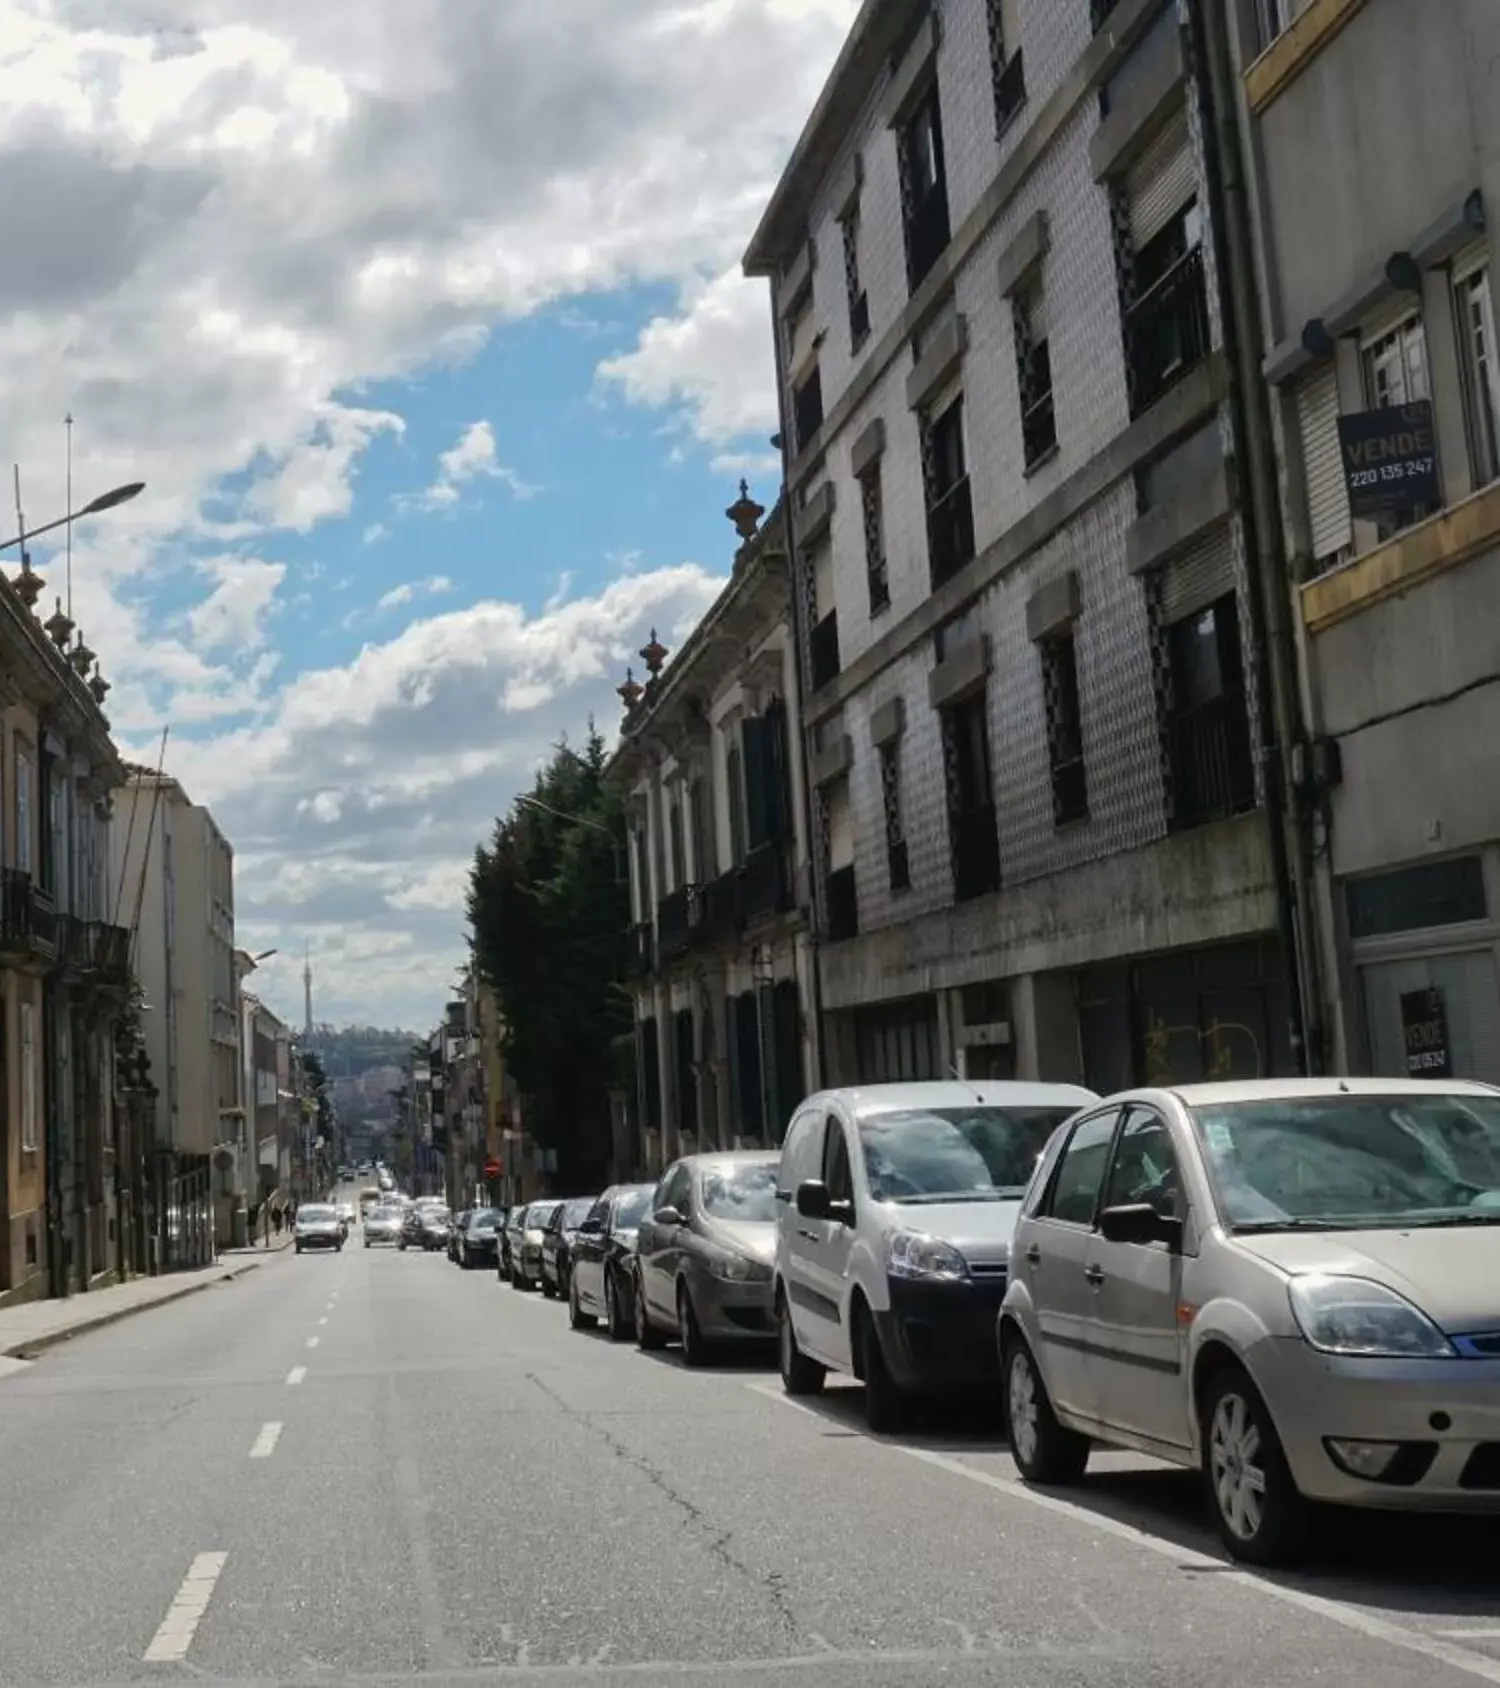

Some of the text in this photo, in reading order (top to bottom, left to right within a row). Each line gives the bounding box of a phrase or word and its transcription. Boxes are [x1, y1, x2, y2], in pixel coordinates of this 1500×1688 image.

[1347, 430, 1430, 465] VENDE
[1351, 457, 1432, 487] 220 135 247
